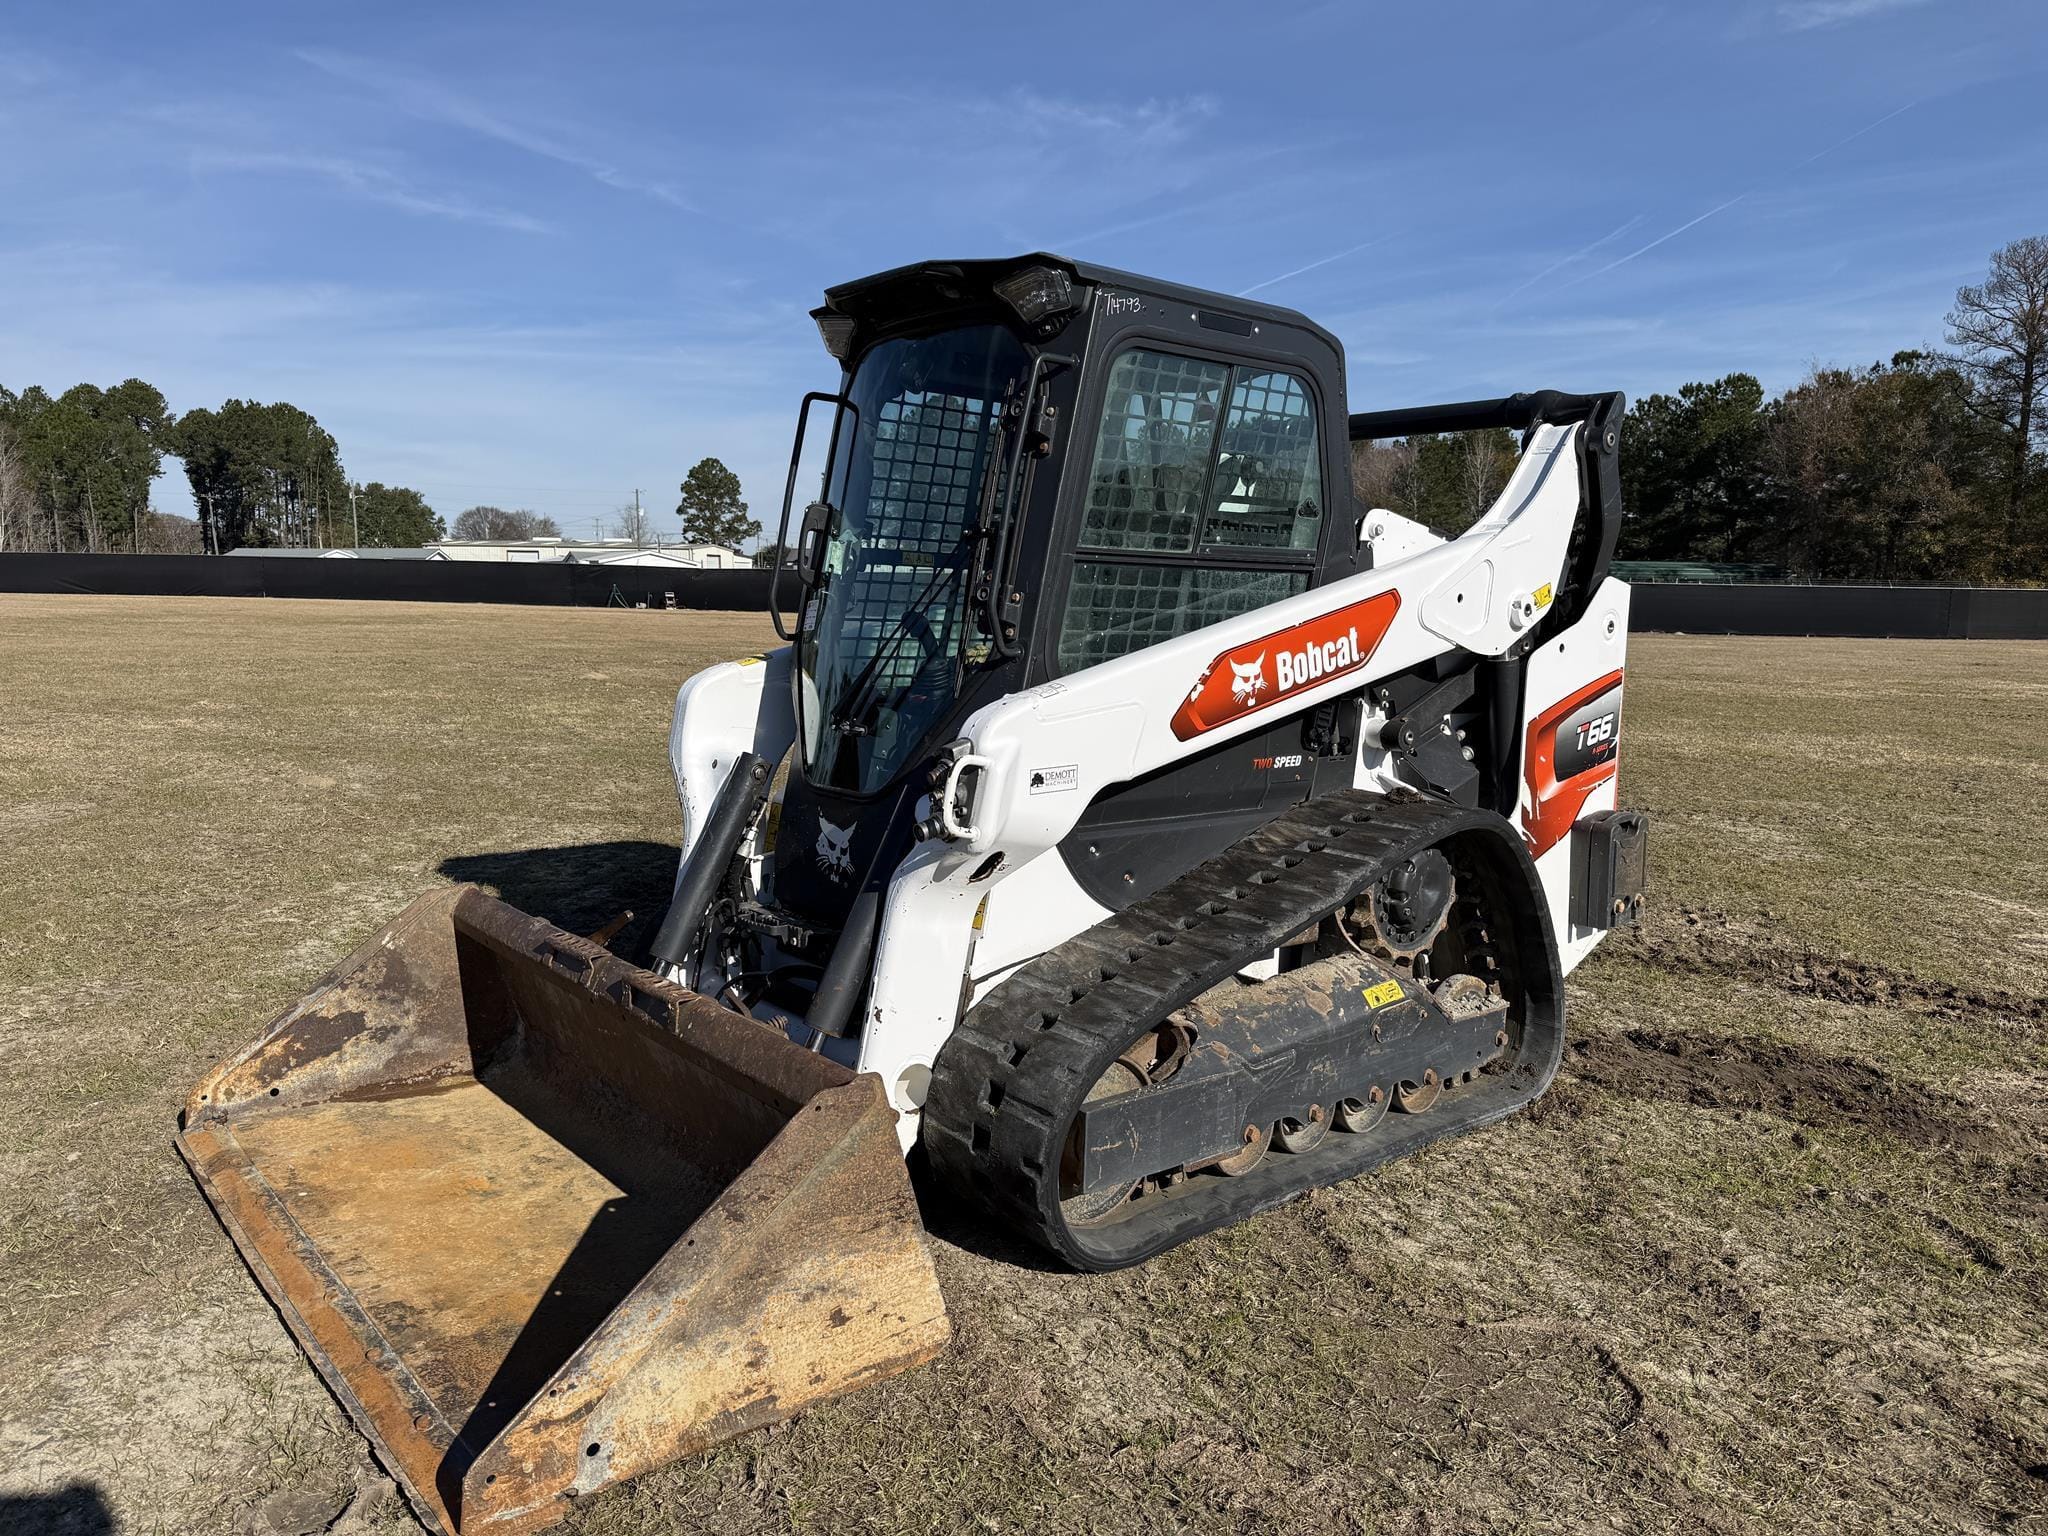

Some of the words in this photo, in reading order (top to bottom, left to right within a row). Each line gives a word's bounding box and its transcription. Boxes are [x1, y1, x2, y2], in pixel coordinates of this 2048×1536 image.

[1275, 626, 1360, 692] Bobcat
[1576, 712, 1614, 751] T66
[1045, 769, 1076, 781] DEMOTT
[1253, 758, 1273, 769] TWO
[1274, 755, 1302, 769] SPEED
